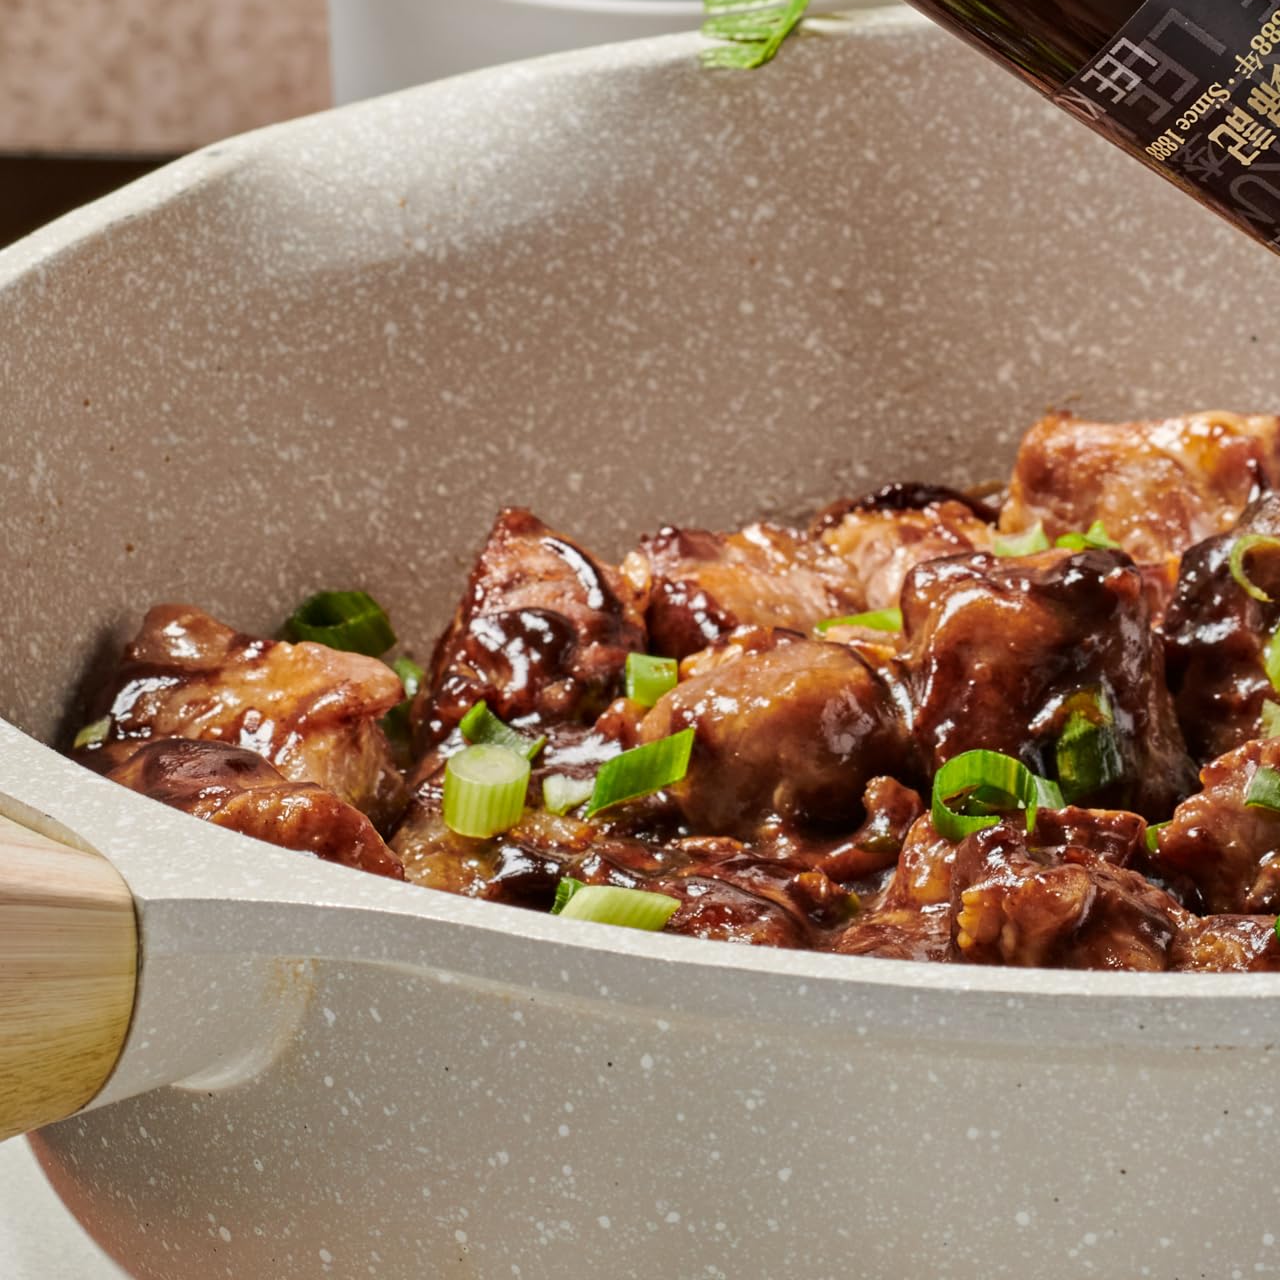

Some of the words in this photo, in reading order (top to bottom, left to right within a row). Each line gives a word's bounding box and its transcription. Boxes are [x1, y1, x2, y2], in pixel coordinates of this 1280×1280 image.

[1078, 35, 1158, 106] LEE
[1173, 80, 1233, 135] Since
[1143, 126, 1187, 163] 1888
